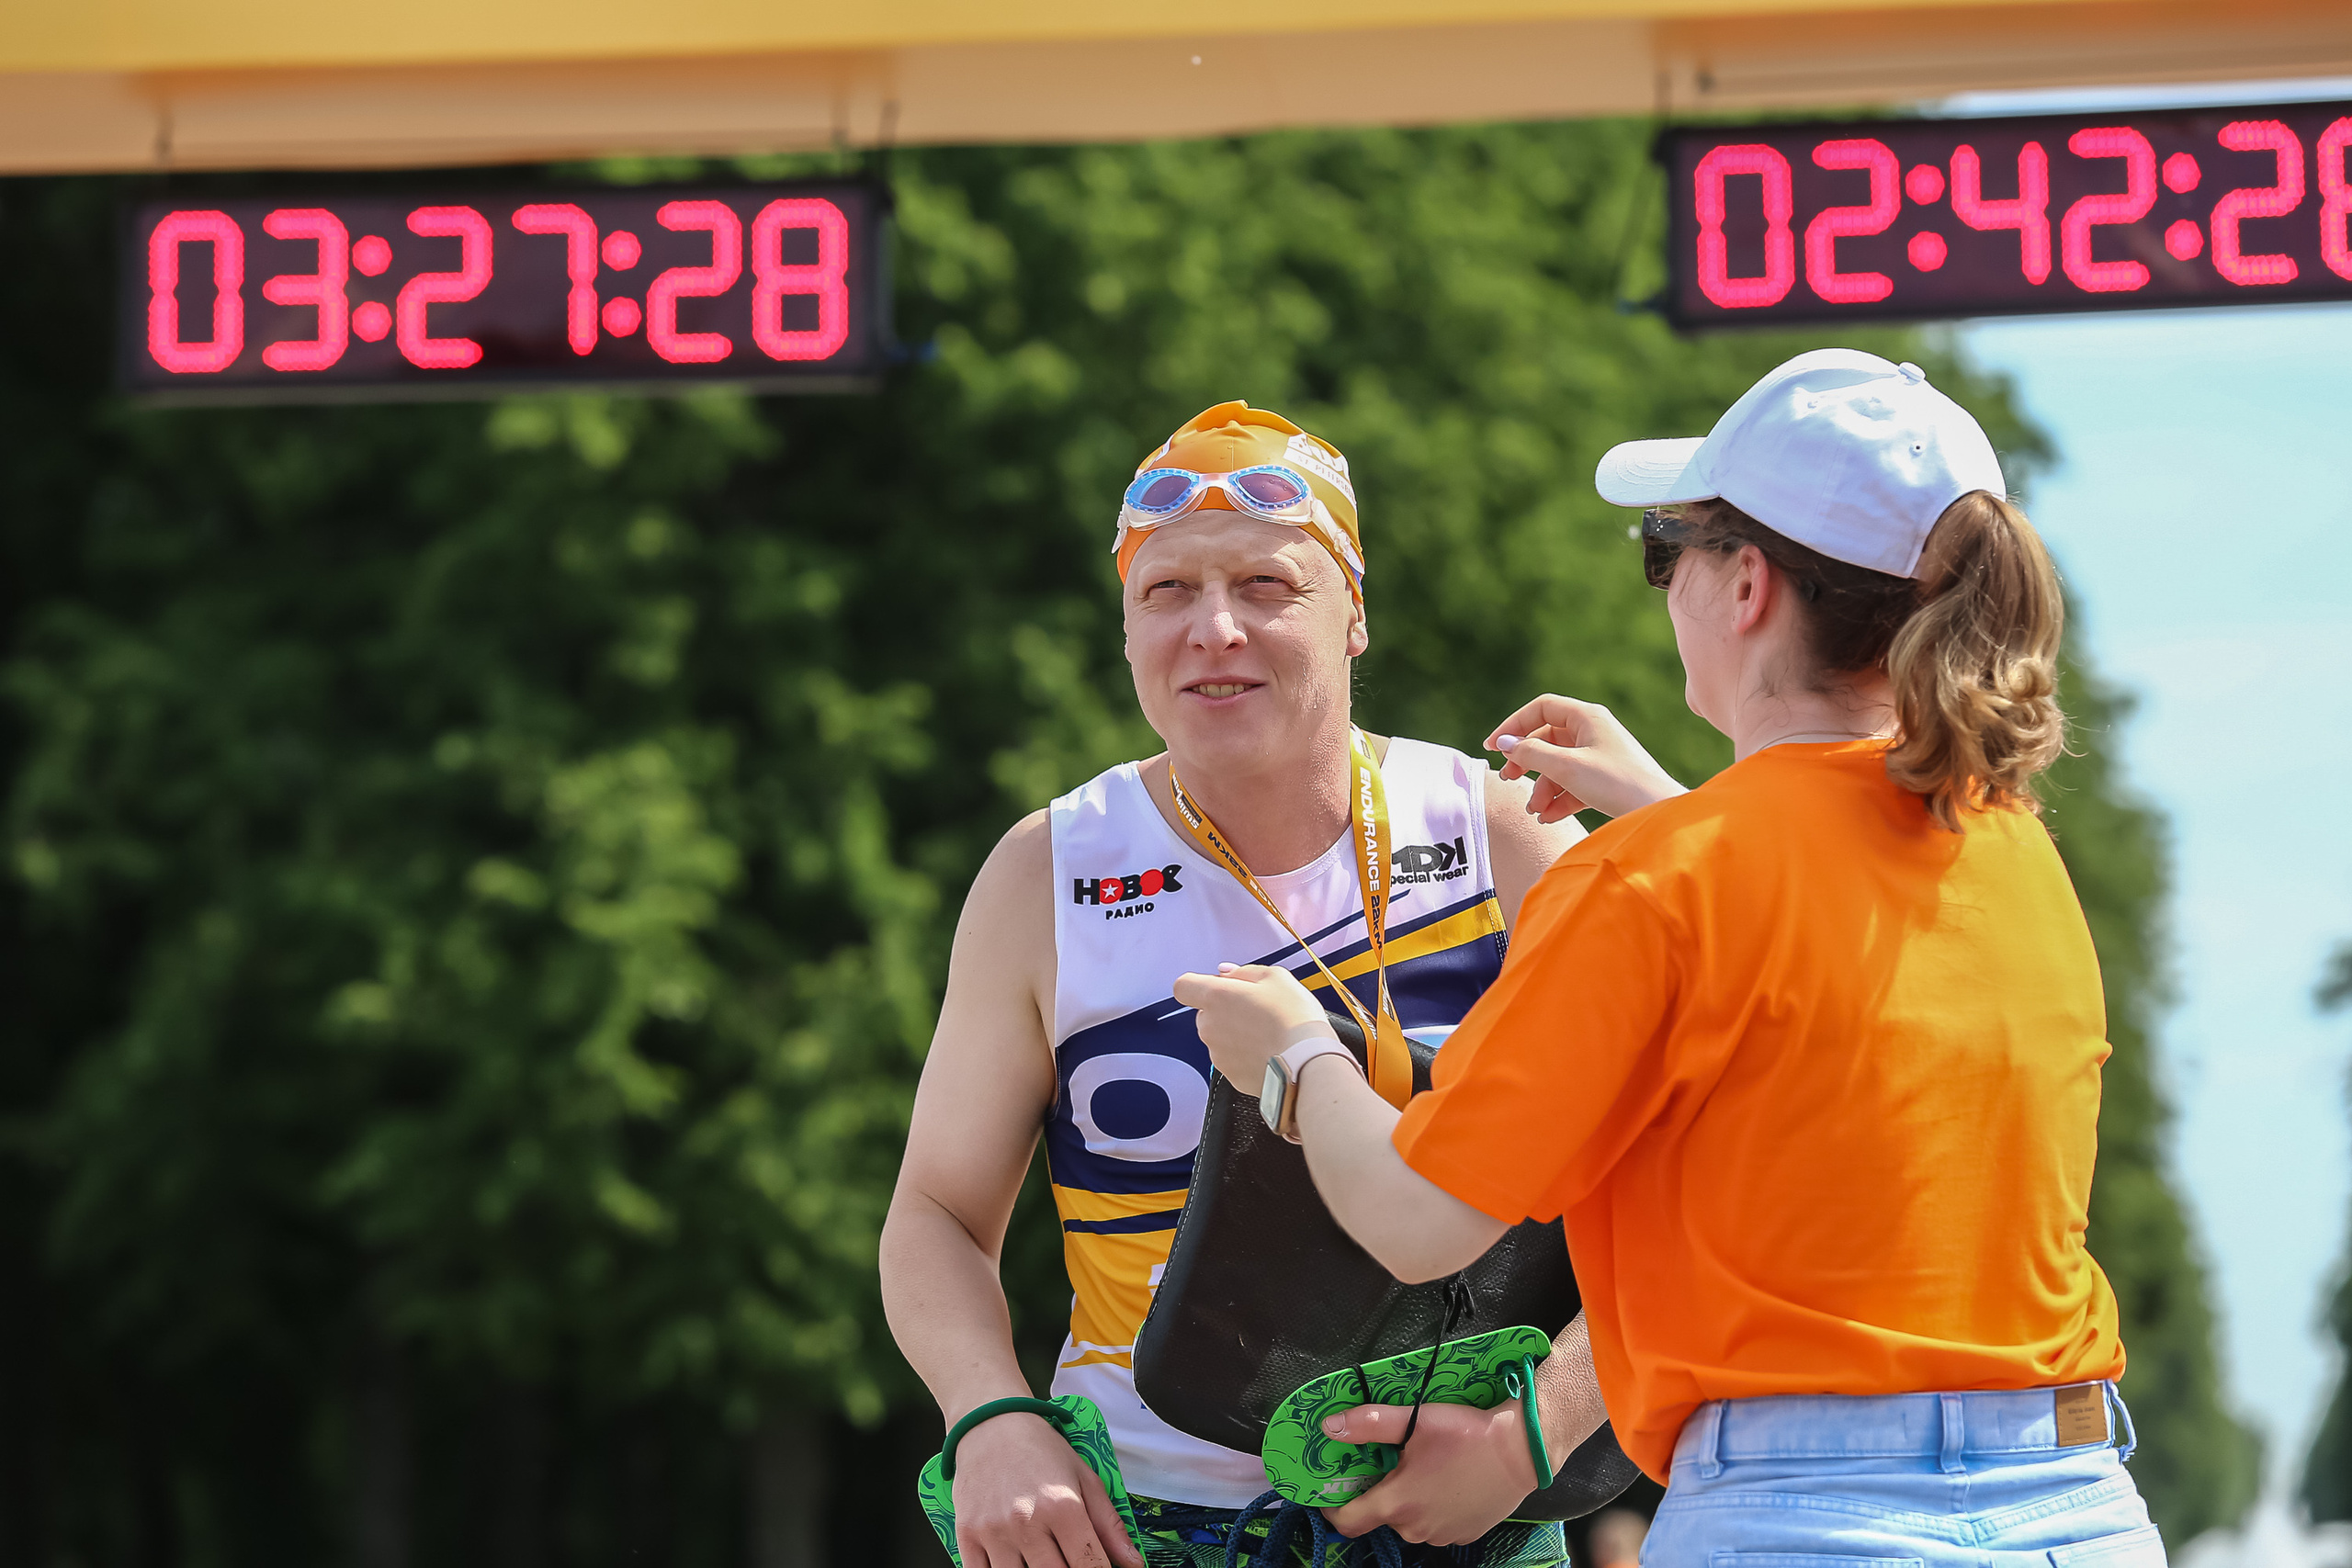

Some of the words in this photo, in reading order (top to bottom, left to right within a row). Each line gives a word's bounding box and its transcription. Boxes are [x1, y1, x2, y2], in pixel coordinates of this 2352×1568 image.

[148, 198, 849, 373] 03:27:28
[1206, 830, 1249, 879] 22KM
[1360, 766, 1380, 891] ENDURANCE
[1370, 894, 1383, 951] 22KM
[1389, 871, 1430, 887] pecial
[1433, 865, 1469, 883] wear
[1105, 902, 1155, 920] РАДИО
